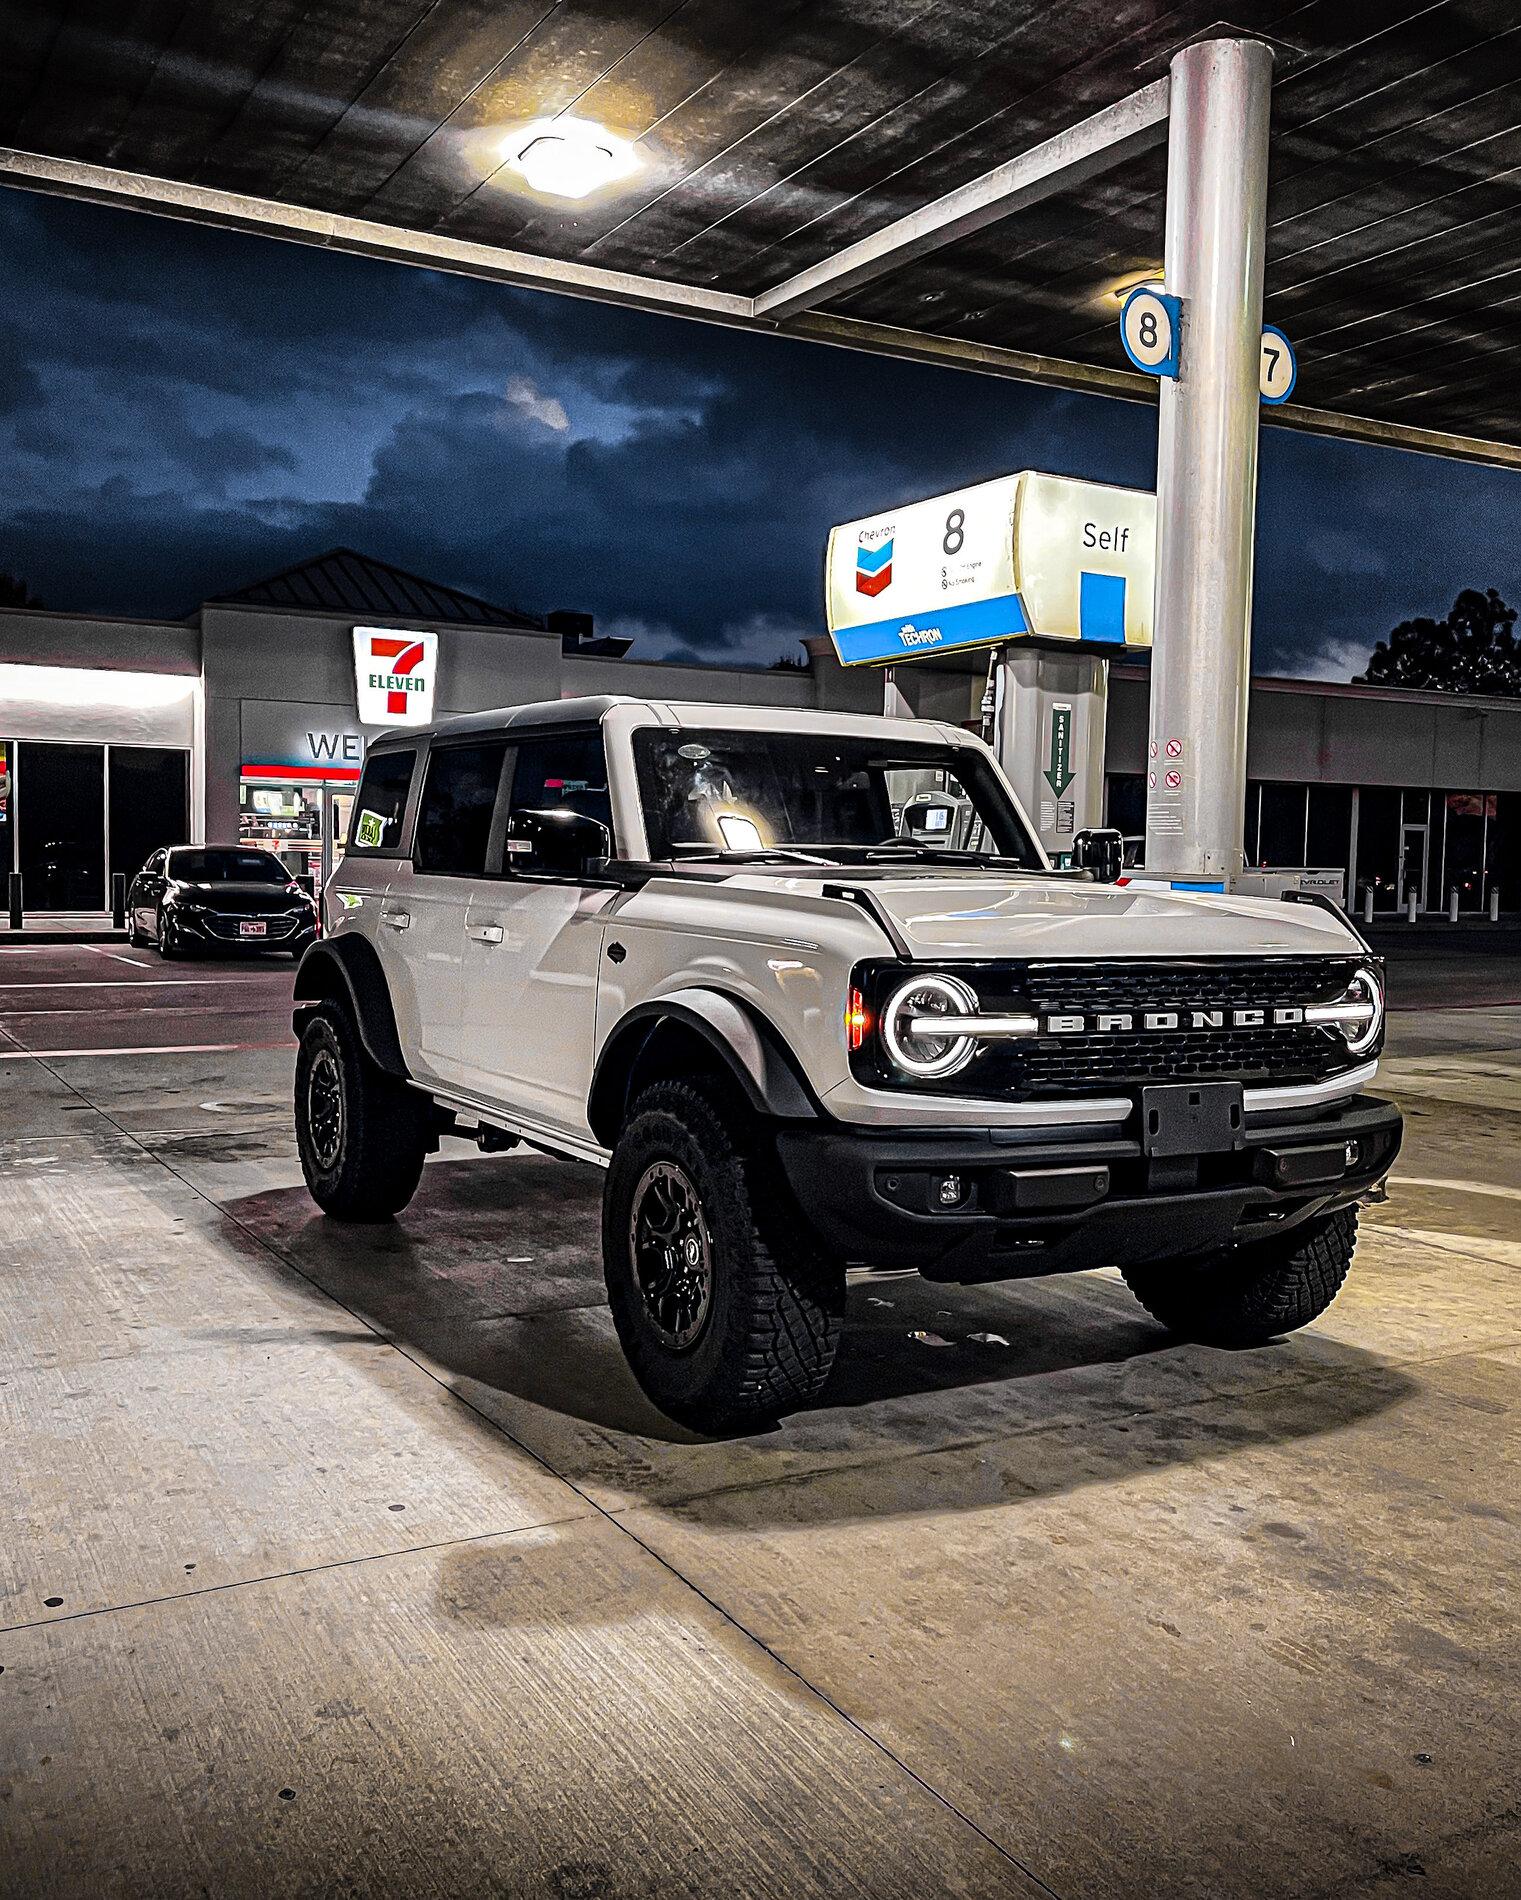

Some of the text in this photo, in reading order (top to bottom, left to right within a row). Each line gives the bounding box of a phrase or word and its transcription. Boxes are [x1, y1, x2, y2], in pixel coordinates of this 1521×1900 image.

[1139, 312, 1157, 348] 8
[1263, 347, 1280, 382] 7
[858, 525, 896, 543] Chevron
[943, 508, 965, 555] 8
[1083, 522, 1129, 552] Self
[898, 627, 943, 647] TECHRON
[371, 637, 425, 714] 7
[1055, 715, 1064, 788] SANITIZER
[1047, 1008, 1303, 1033] BRONCO
